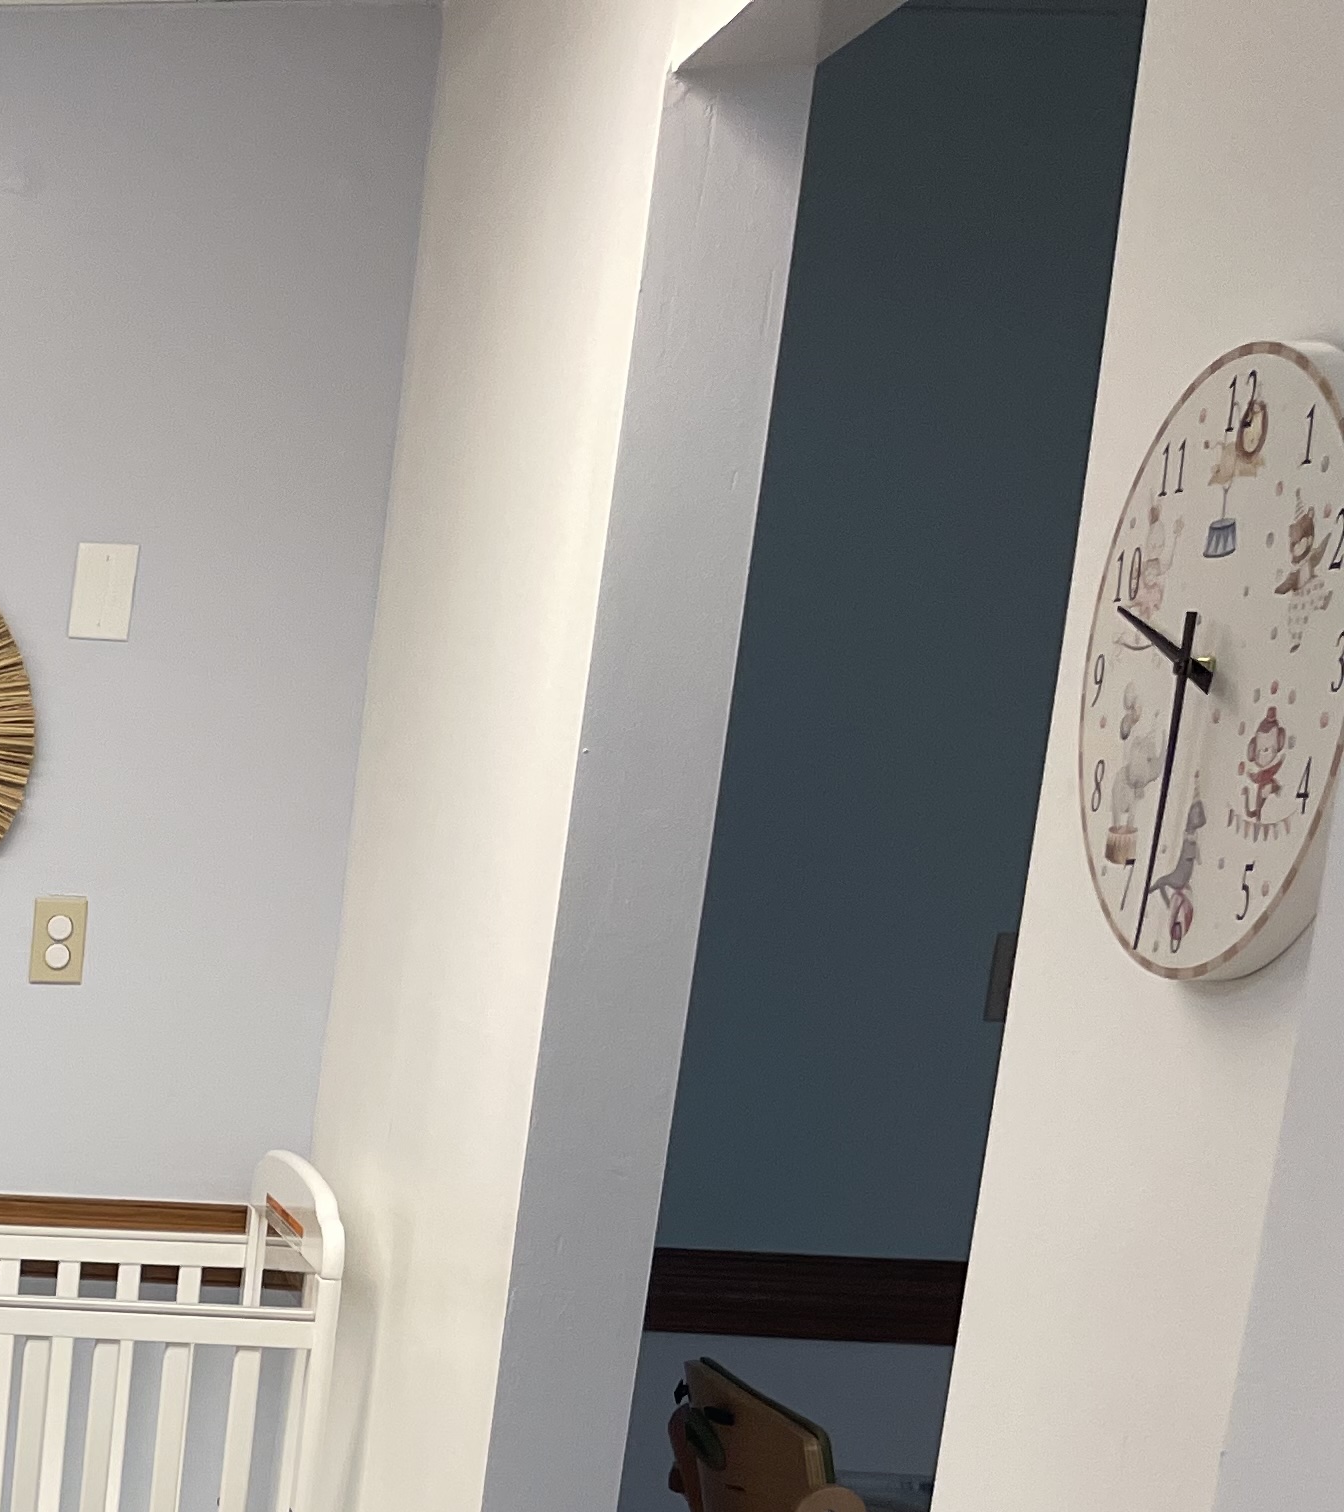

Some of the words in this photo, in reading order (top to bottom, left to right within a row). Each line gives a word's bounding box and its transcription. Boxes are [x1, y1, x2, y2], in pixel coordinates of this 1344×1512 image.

[1224, 369, 1258, 432] 12
[1302, 404, 1316, 466] 1
[1158, 438, 1186, 497] 11
[1112, 547, 1142, 603] 10
[1091, 653, 1105, 708] 9
[1091, 759, 1105, 813] 8
[1295, 756, 1312, 815] 4
[1119, 857, 1137, 911] 7
[1236, 860, 1256, 921] 5
